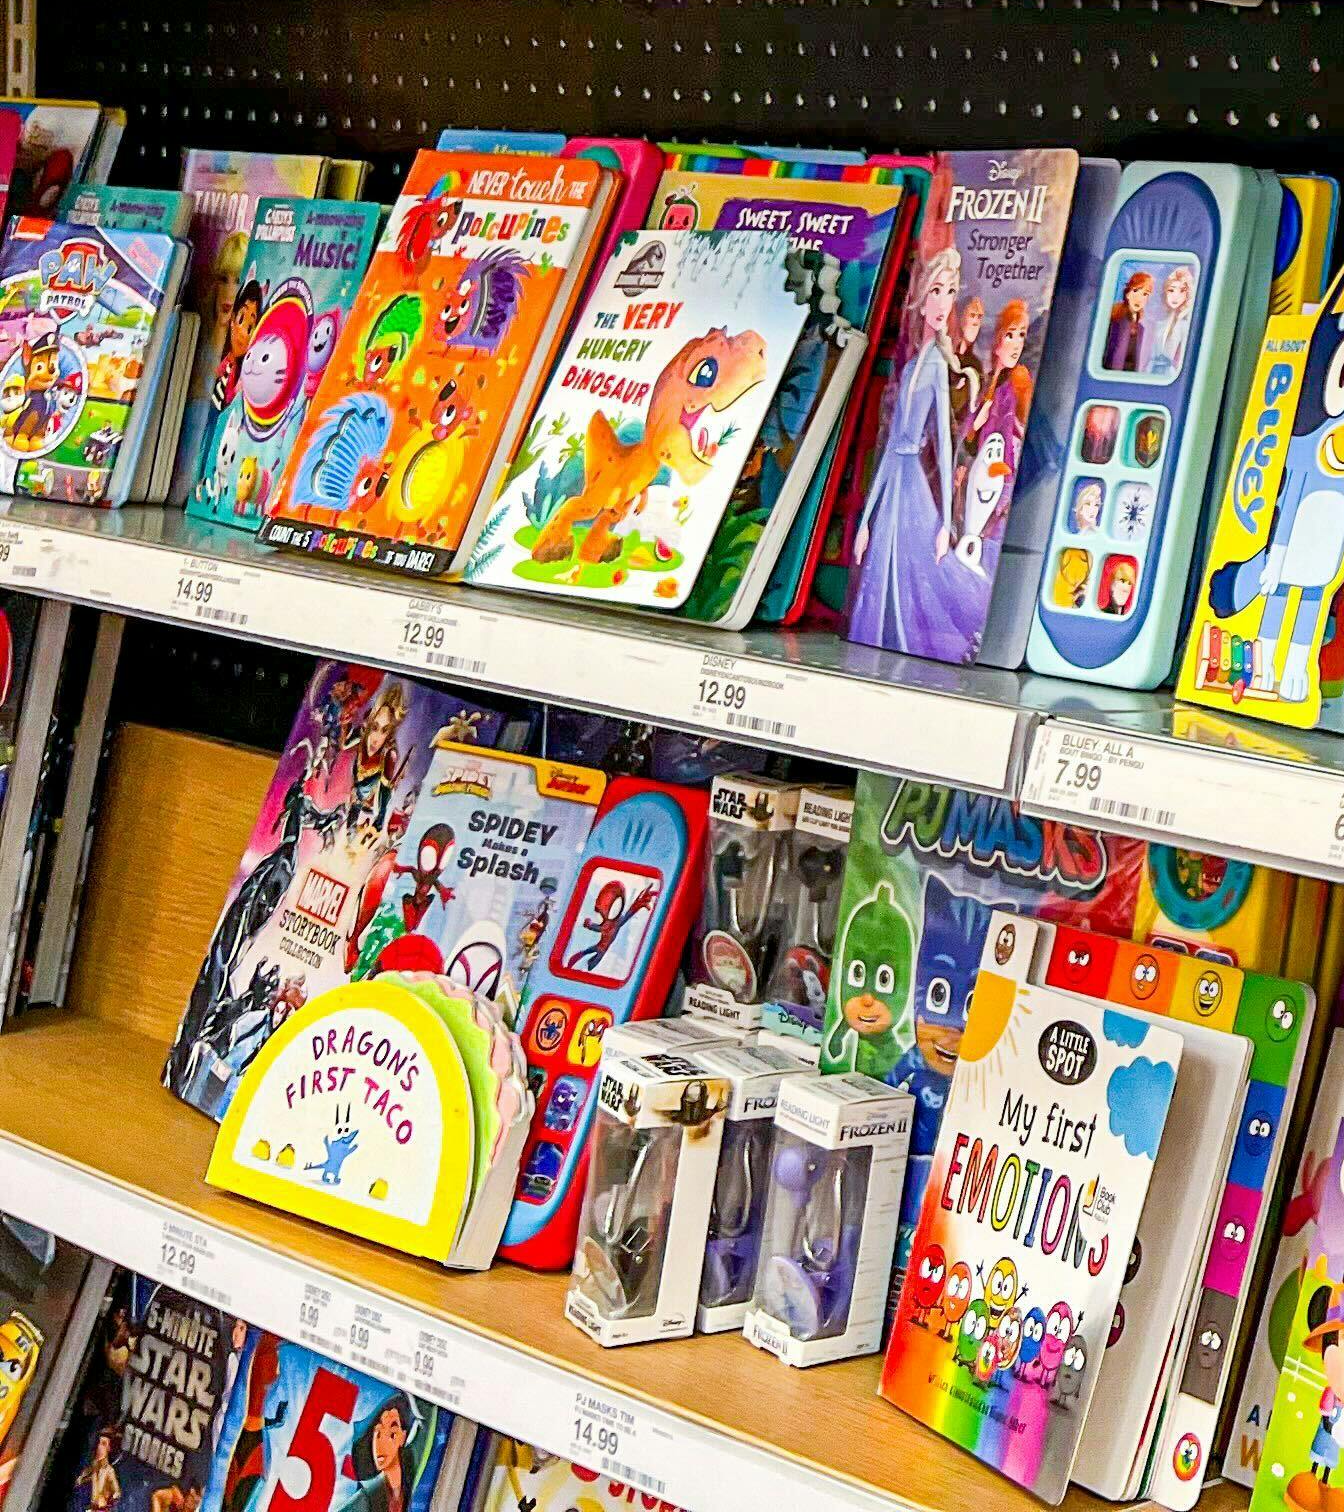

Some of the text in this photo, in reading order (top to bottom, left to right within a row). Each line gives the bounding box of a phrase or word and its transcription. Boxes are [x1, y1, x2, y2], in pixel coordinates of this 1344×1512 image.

[467, 163, 570, 203] NEVER touch
[735, 207, 854, 235] SWEET, SWEET
[945, 185, 1027, 224] FROZEN
[293, 229, 363, 271] Music!
[967, 229, 1034, 260] Stronger
[976, 259, 1045, 285] Together
[45, 294, 87, 310] PATROL
[594, 300, 685, 331] THE VERY
[575, 337, 653, 362] HUNGRY
[176, 578, 214, 604] 14.99
[402, 622, 446, 649] 12.99
[698, 679, 747, 710] 12.99
[1055, 758, 1102, 791] 7.99
[467, 809, 559, 847] SPIDEY
[456, 848, 540, 885] Splash
[298, 869, 349, 924] MARVEL
[312, 1025, 420, 1092] DRAGON'S
[1045, 1045, 1086, 1081] SPOT
[285, 1067, 413, 1146] FIRST TACO
[998, 1088, 1097, 1160] My first
[146, 1299, 219, 1359] 5-MINUTE
[128, 1333, 216, 1410] STAR
[120, 1369, 211, 1451] WARS
[121, 1422, 186, 1480] STORIES
[573, 1417, 619, 1456] 14.99
